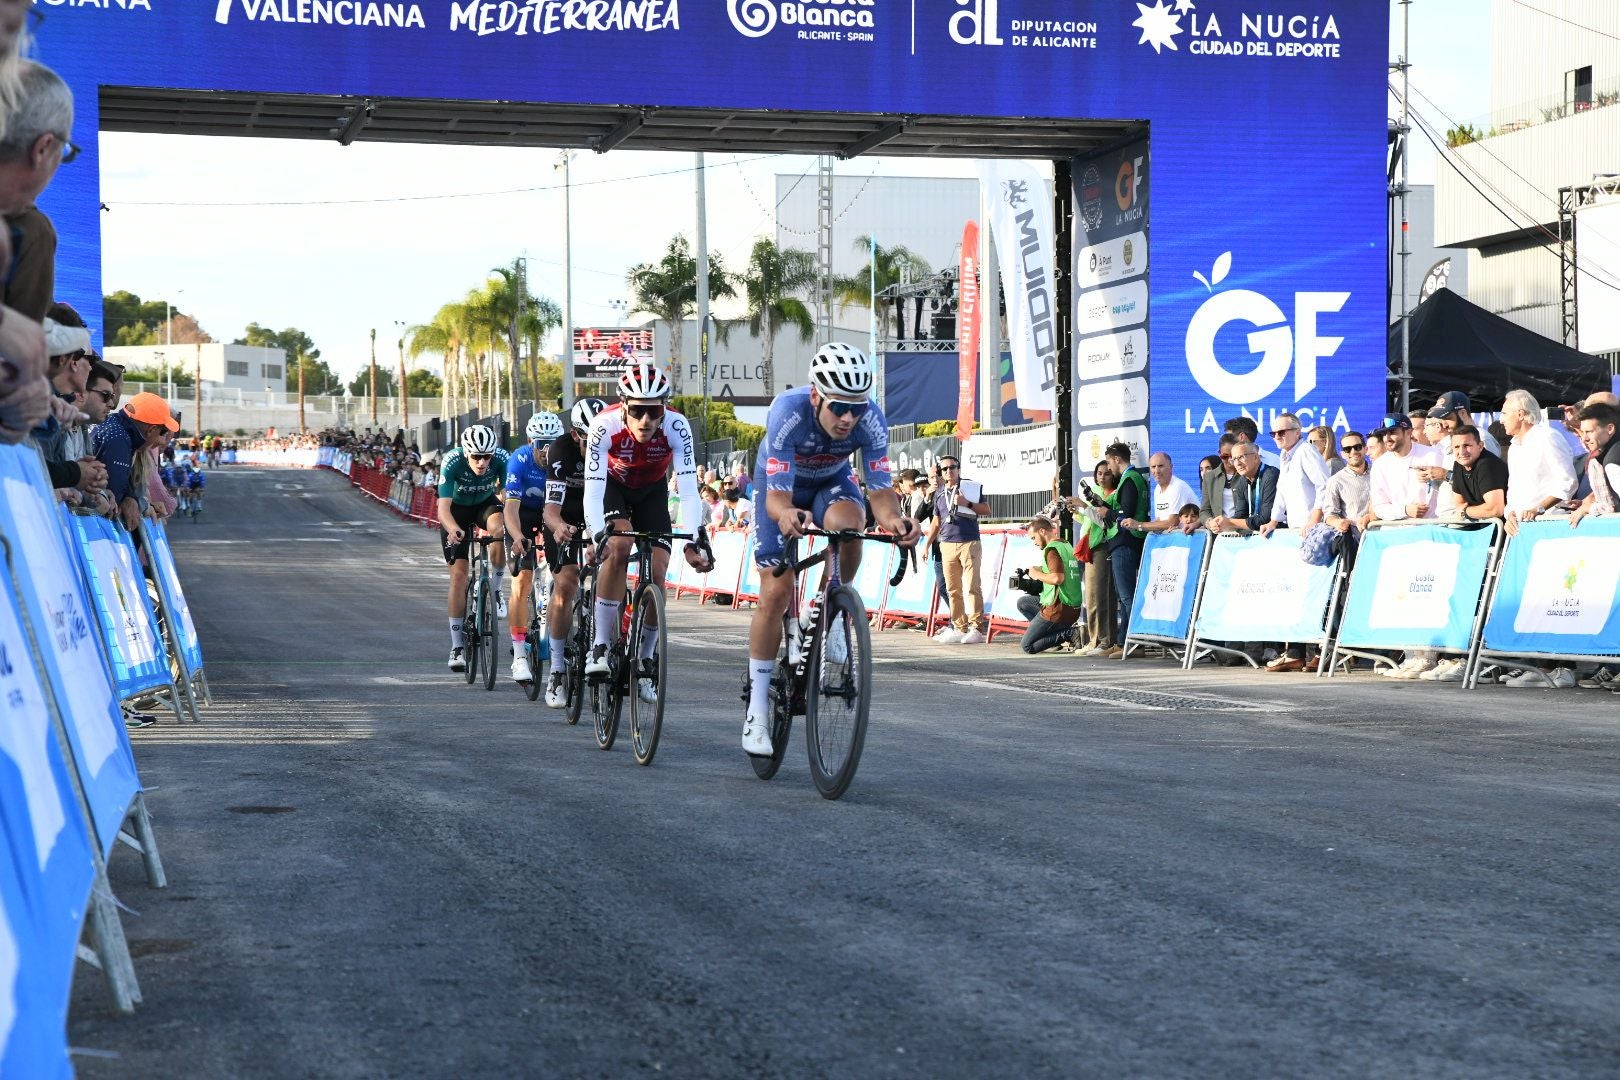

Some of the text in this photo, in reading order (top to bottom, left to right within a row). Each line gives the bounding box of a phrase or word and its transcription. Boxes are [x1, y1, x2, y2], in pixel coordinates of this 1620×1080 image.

[241, 0, 425, 28] VALENCIANA
[781, 2, 875, 27] Blanca
[1012, 20, 1097, 33] DIPUTACION
[1191, 12, 1222, 37] LA
[798, 30, 874, 42] ALICANTE SPAIN
[1012, 36, 1097, 48] DE ALICANTE
[1189, 40, 1340, 58] CIUDAD DEL DEPORTE
[1185, 289, 1352, 404] GF
[690, 364, 764, 380] PVELLO
[1185, 405, 1220, 434] LA
[589, 425, 606, 472] Cofidis
[672, 419, 692, 466] Cofidis
